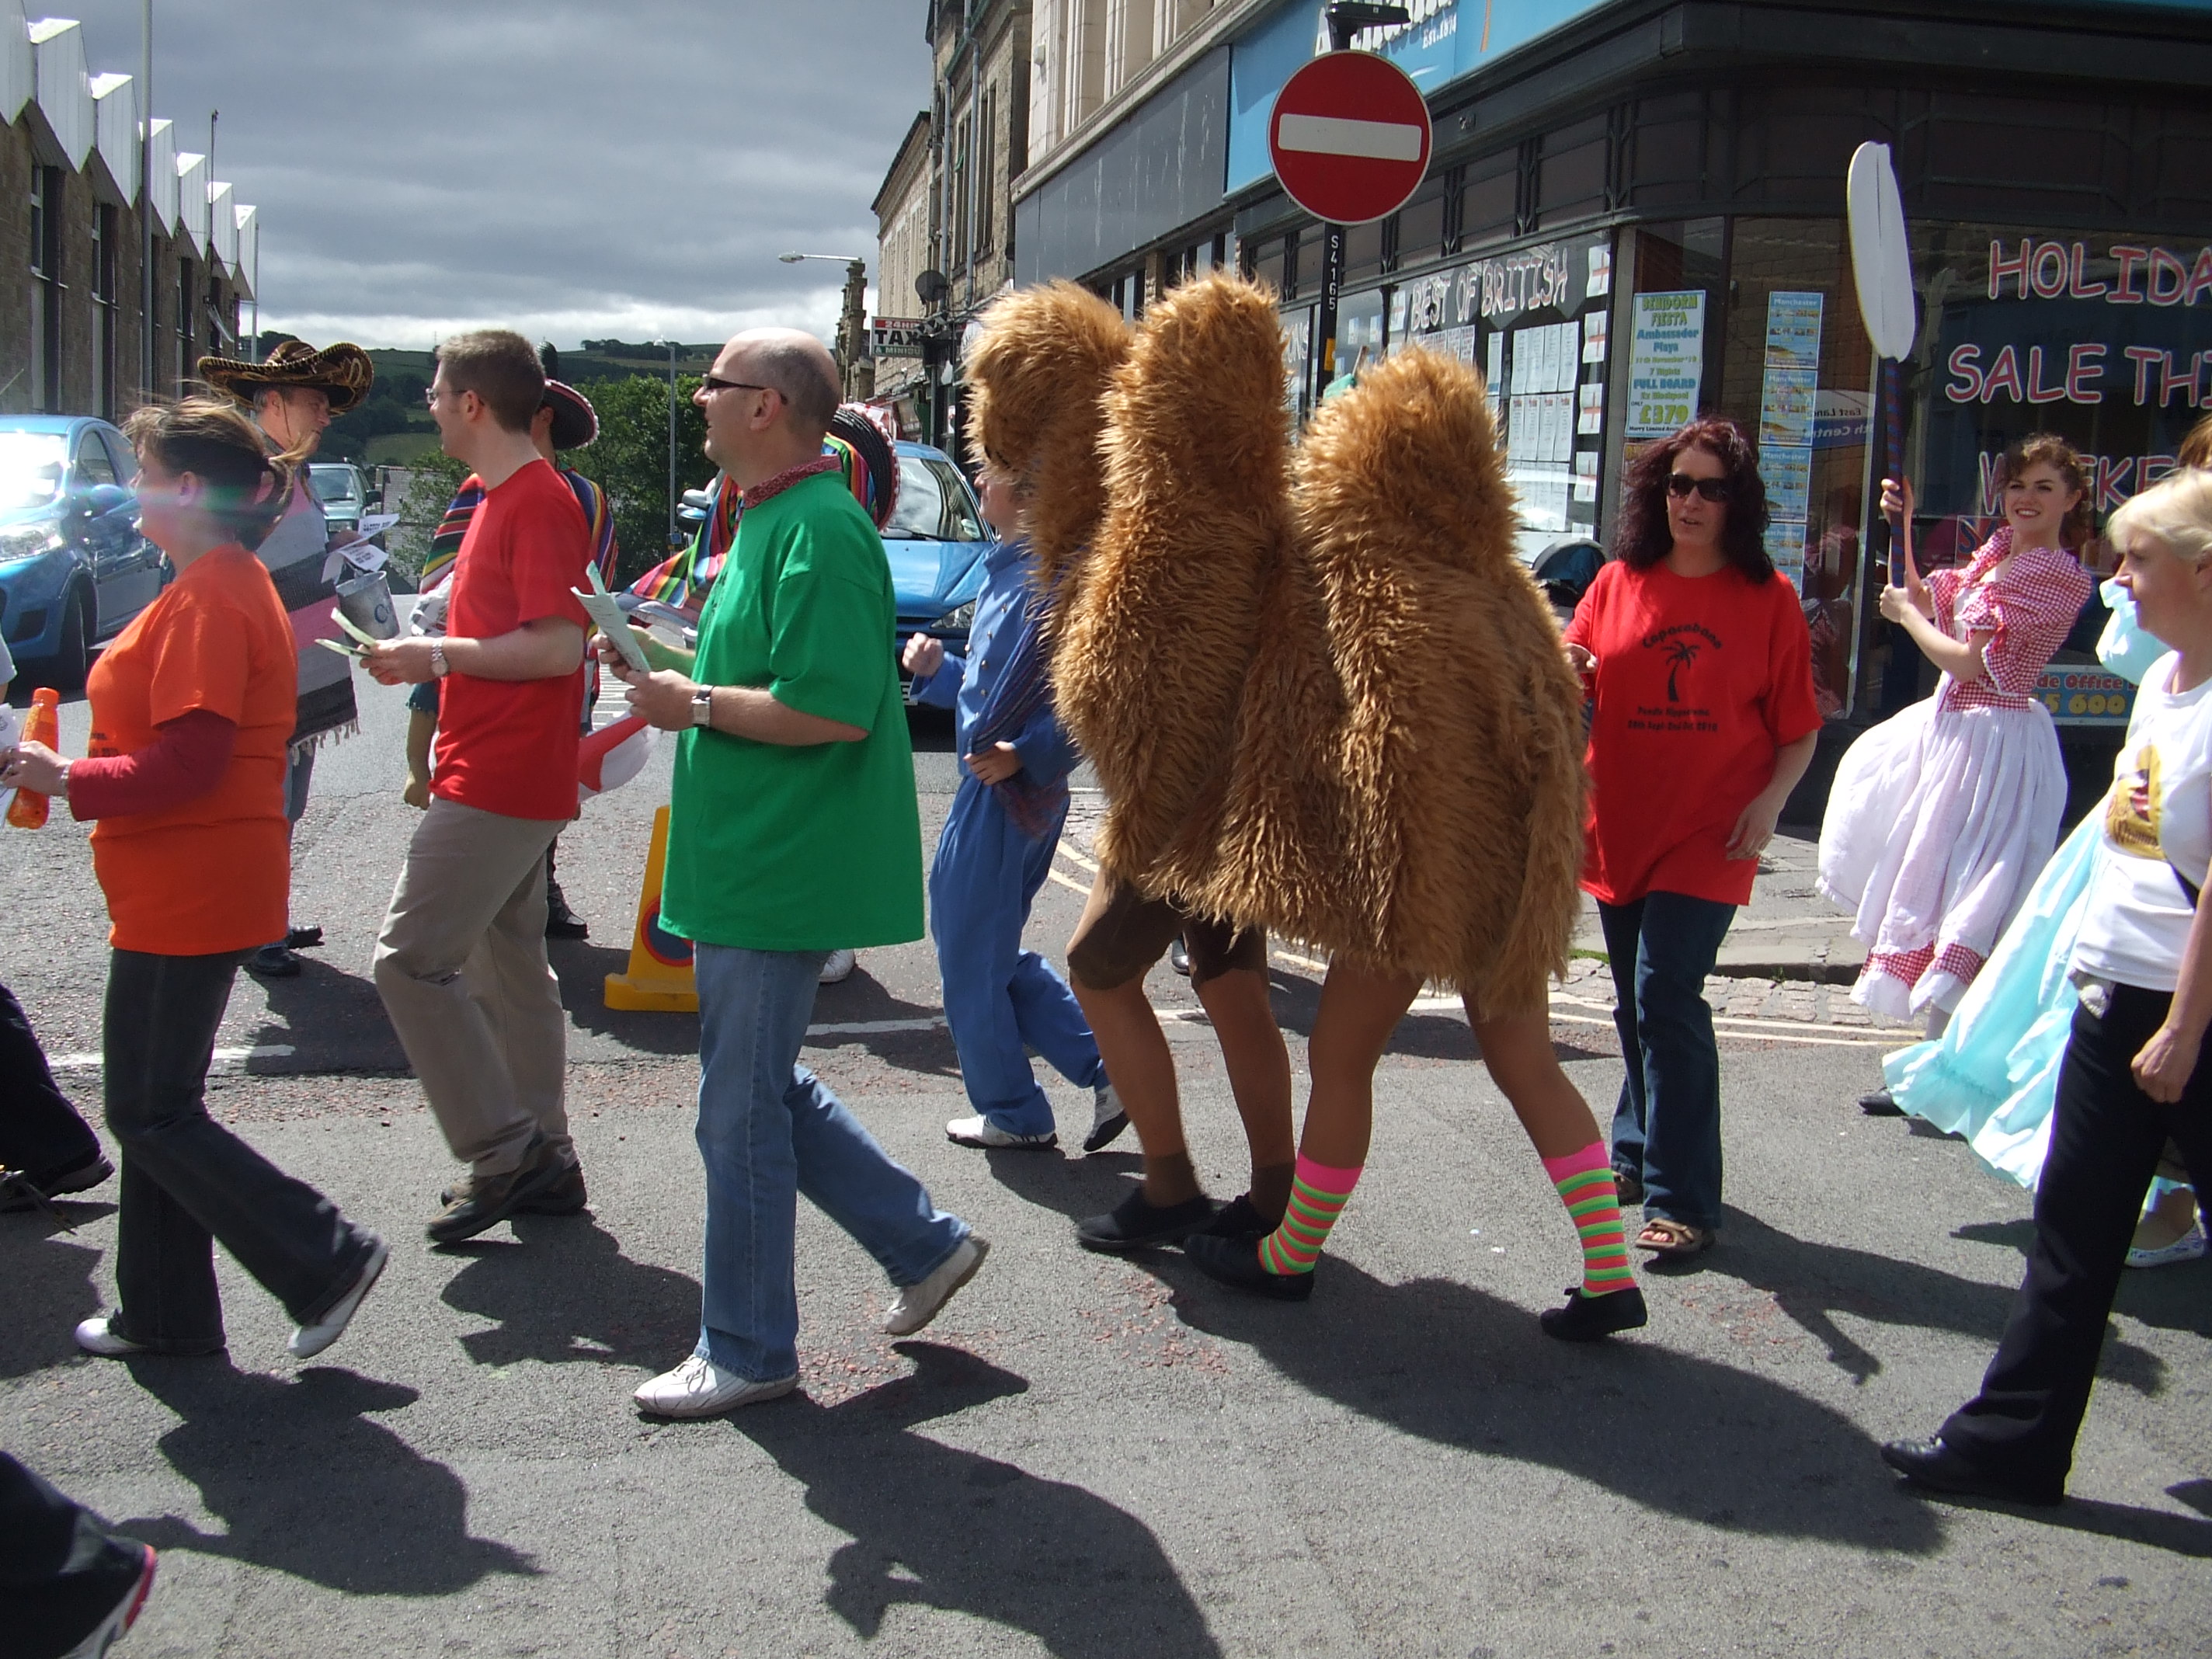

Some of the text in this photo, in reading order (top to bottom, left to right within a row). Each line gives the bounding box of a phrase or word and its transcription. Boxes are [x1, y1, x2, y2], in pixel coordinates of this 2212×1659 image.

[1329, 235, 1341, 311] S4165
[1410, 247, 1568, 332] BEST OF BRITISH
[1773, 297, 1817, 306] Manchester
[1651, 311, 1688, 327] FIESTA
[875, 329, 920, 345] TAX
[1636, 328, 1699, 340] Ambassador
[885, 346, 923, 356] MINIBU
[1945, 343, 2107, 405] SALE
[1633, 377, 1697, 390] FULL BOARD
[1640, 405, 1689, 425] £379
[1765, 530, 1801, 538] anchester
[2064, 673, 2123, 690] Office
[2068, 694, 2126, 715] 600
